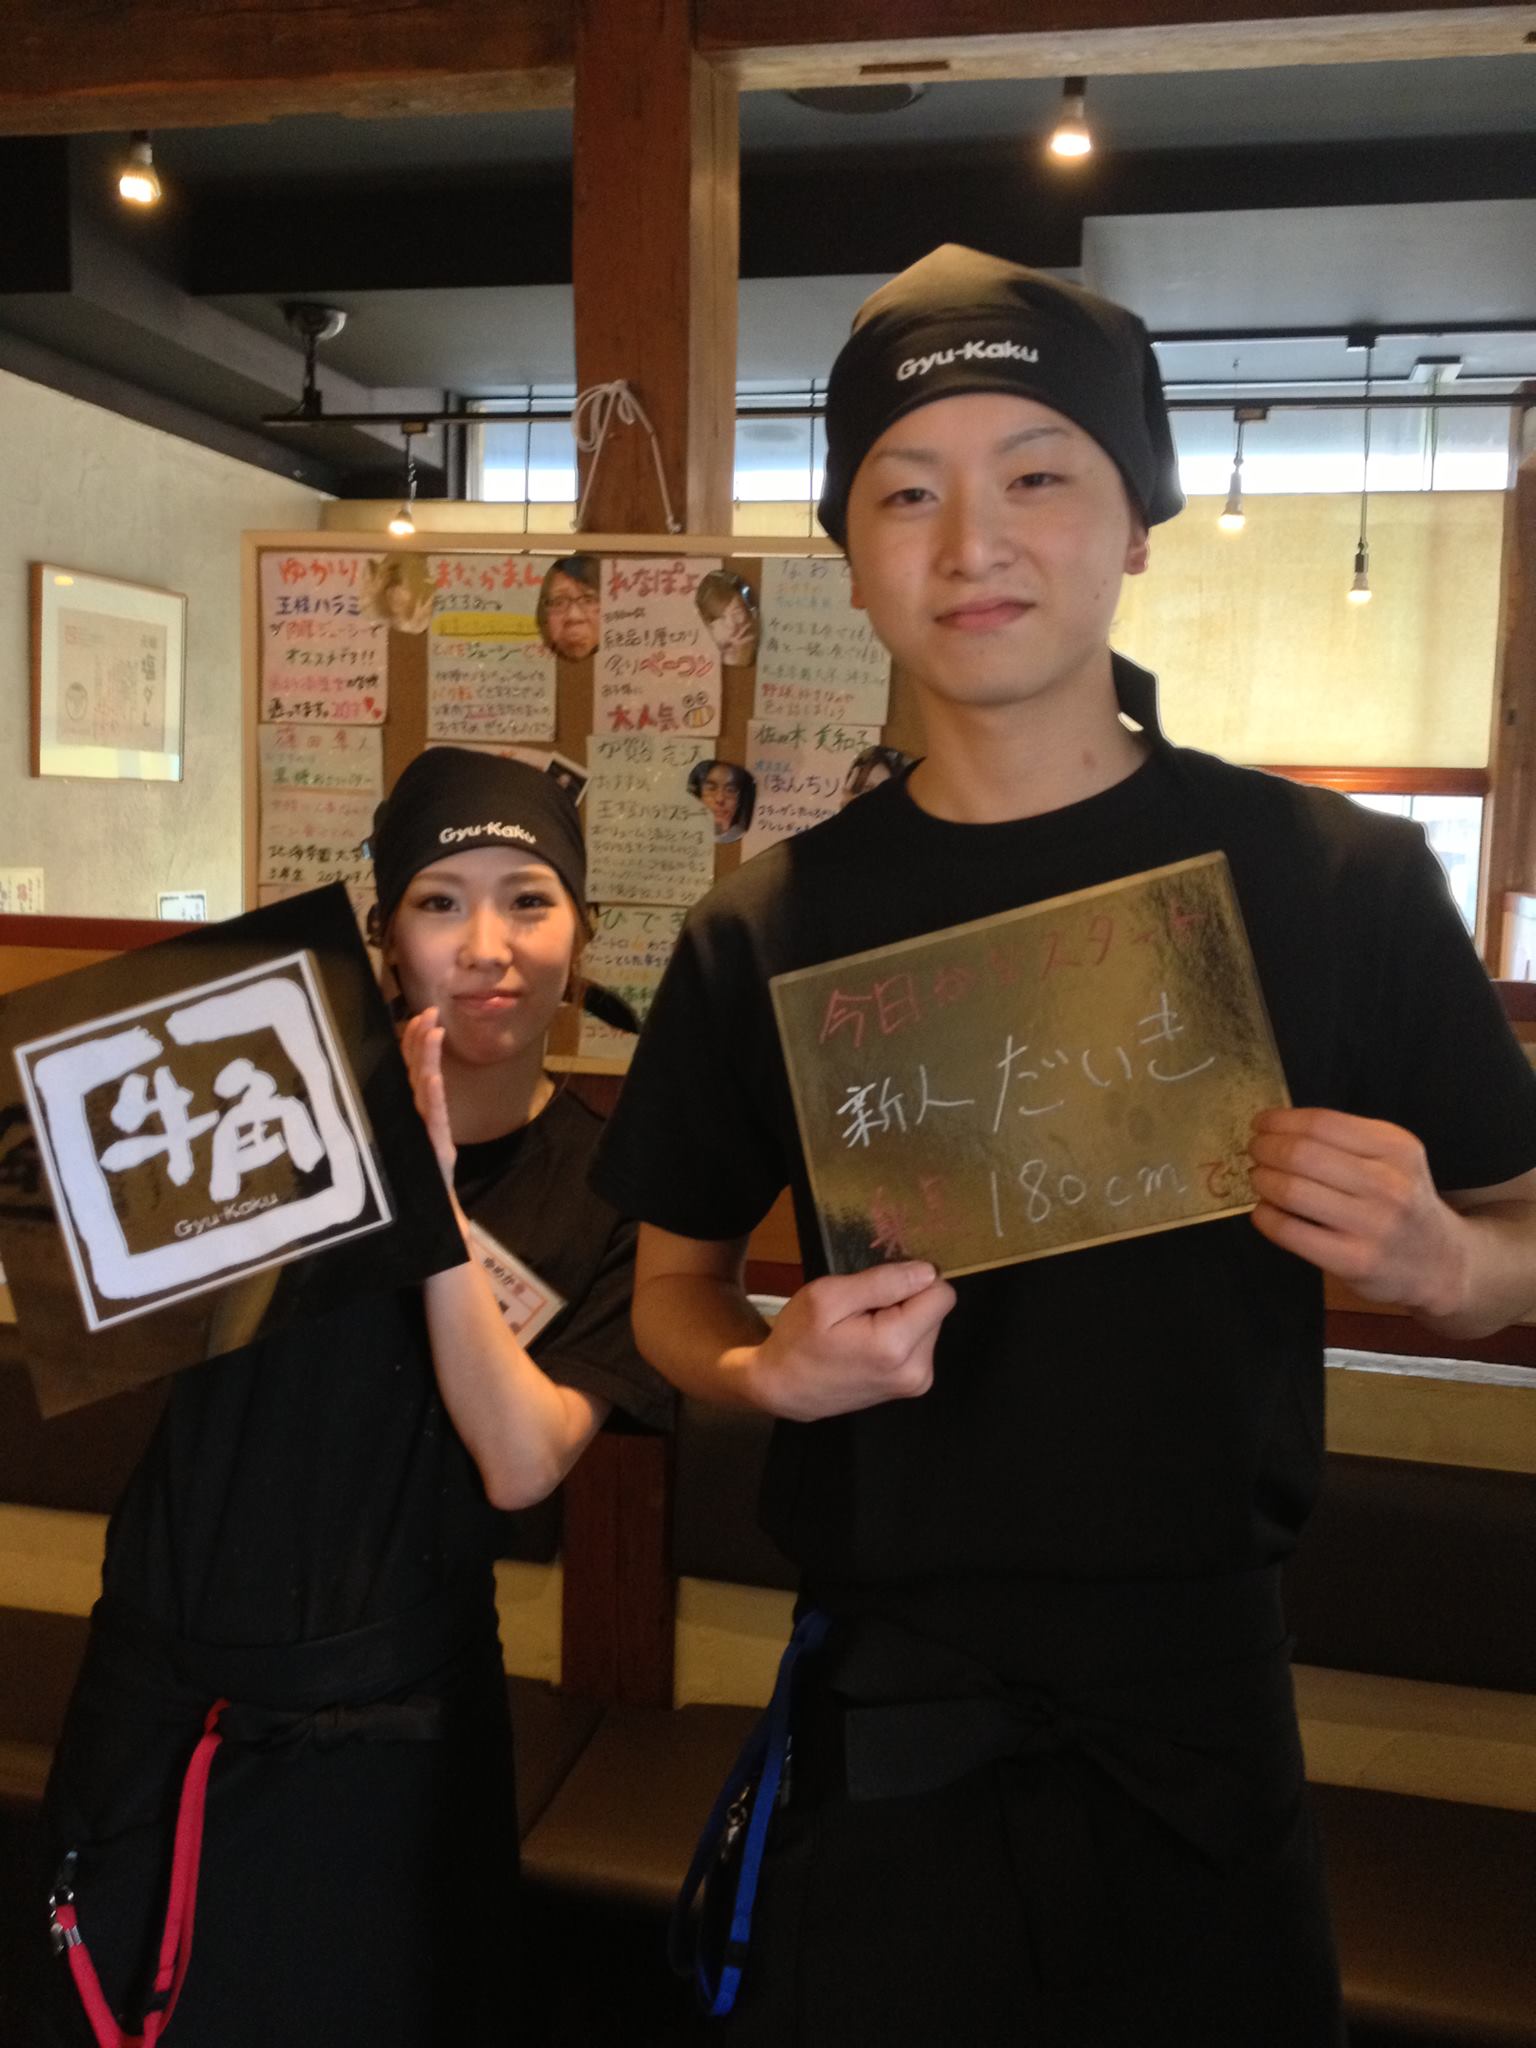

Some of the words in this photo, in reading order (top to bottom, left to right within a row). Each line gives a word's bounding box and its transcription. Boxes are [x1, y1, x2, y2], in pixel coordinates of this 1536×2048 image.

[896, 340, 1039, 382] Gyu-Kaku
[607, 702, 679, 733] 大人気
[439, 820, 537, 845] Gyu-Kaku
[100, 1057, 326, 1202] 牛角
